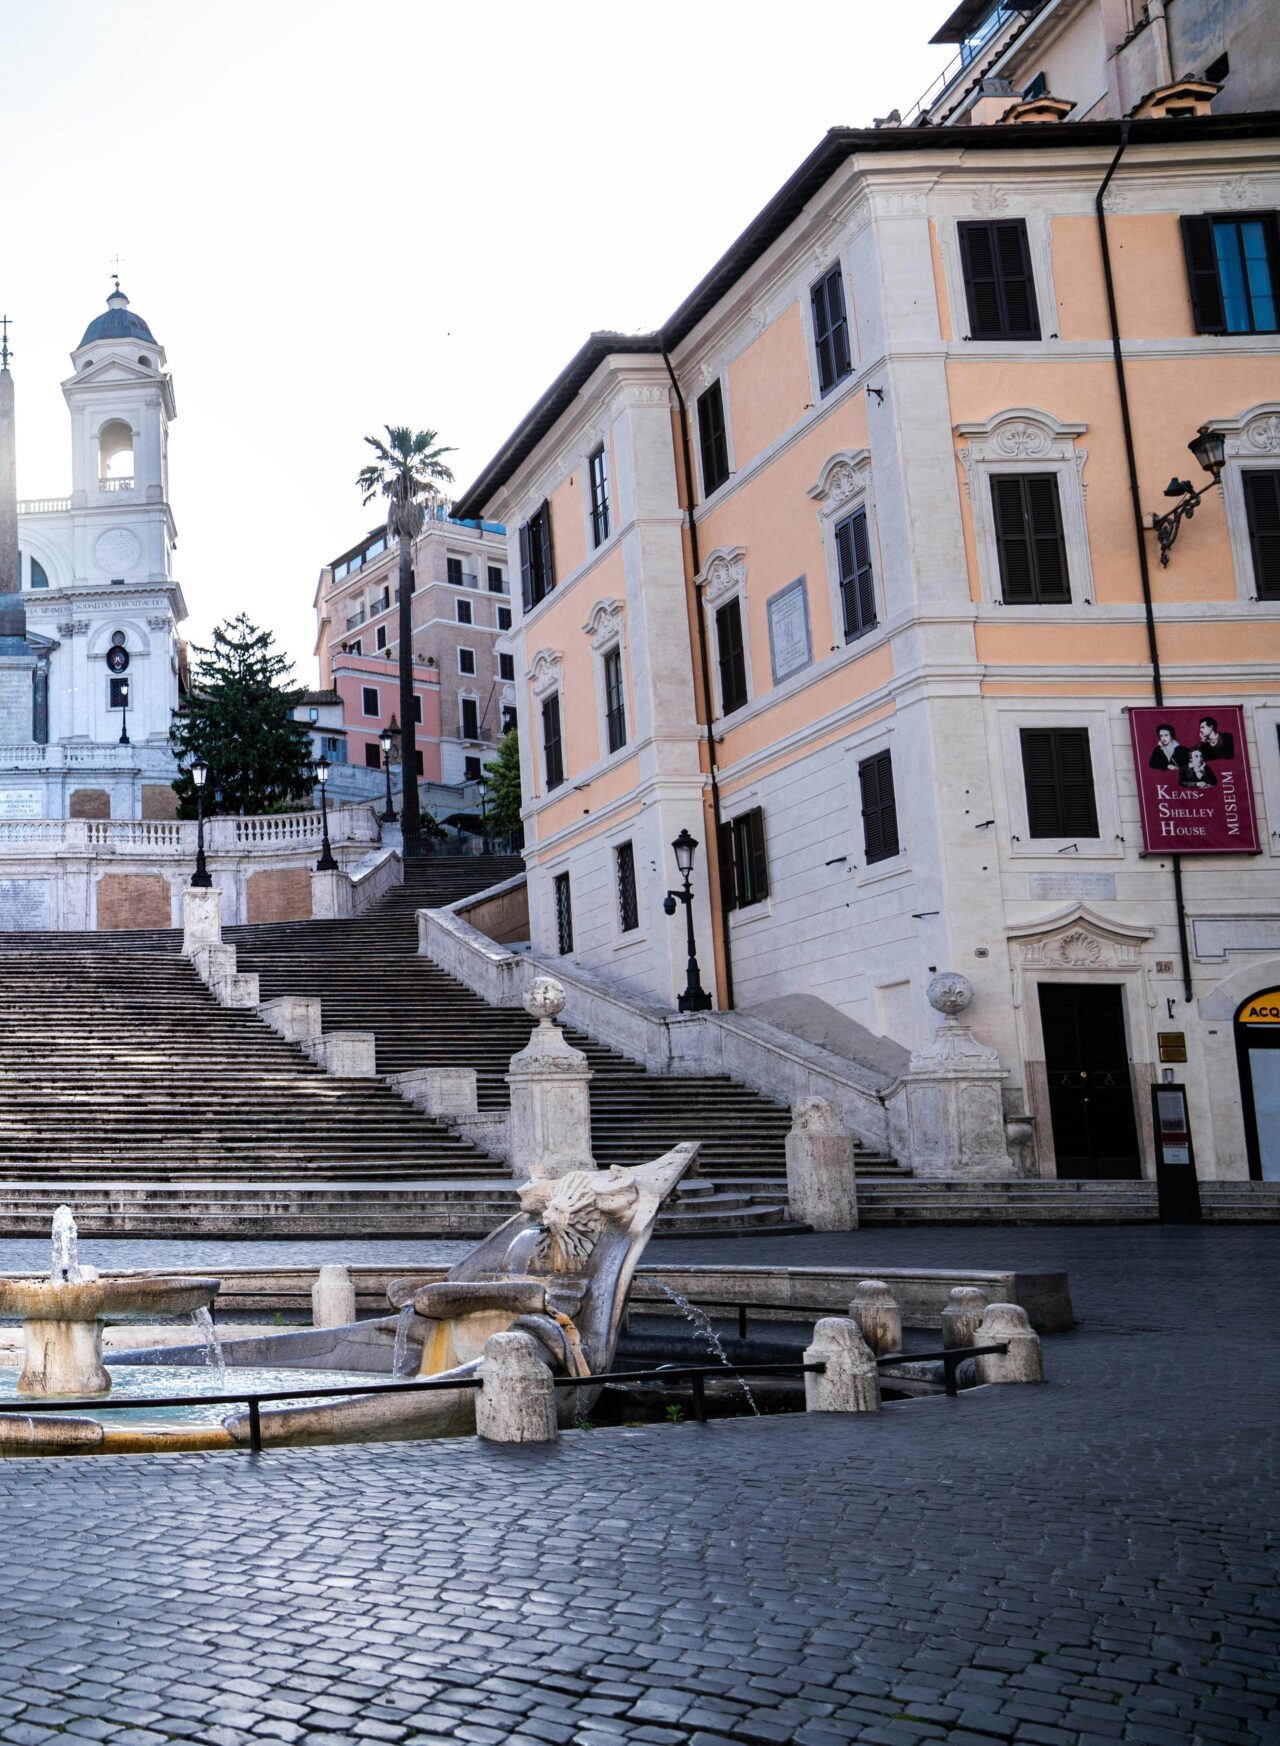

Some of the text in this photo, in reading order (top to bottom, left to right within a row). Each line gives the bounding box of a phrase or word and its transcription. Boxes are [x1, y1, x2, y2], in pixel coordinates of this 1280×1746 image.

[1158, 803, 1215, 818] SHELLEY
[1221, 771, 1240, 835] MUSEUM
[1160, 821, 1207, 836] HOUSE
[1159, 962, 1172, 973] 26
[1249, 1006, 1280, 1018] ACQ
